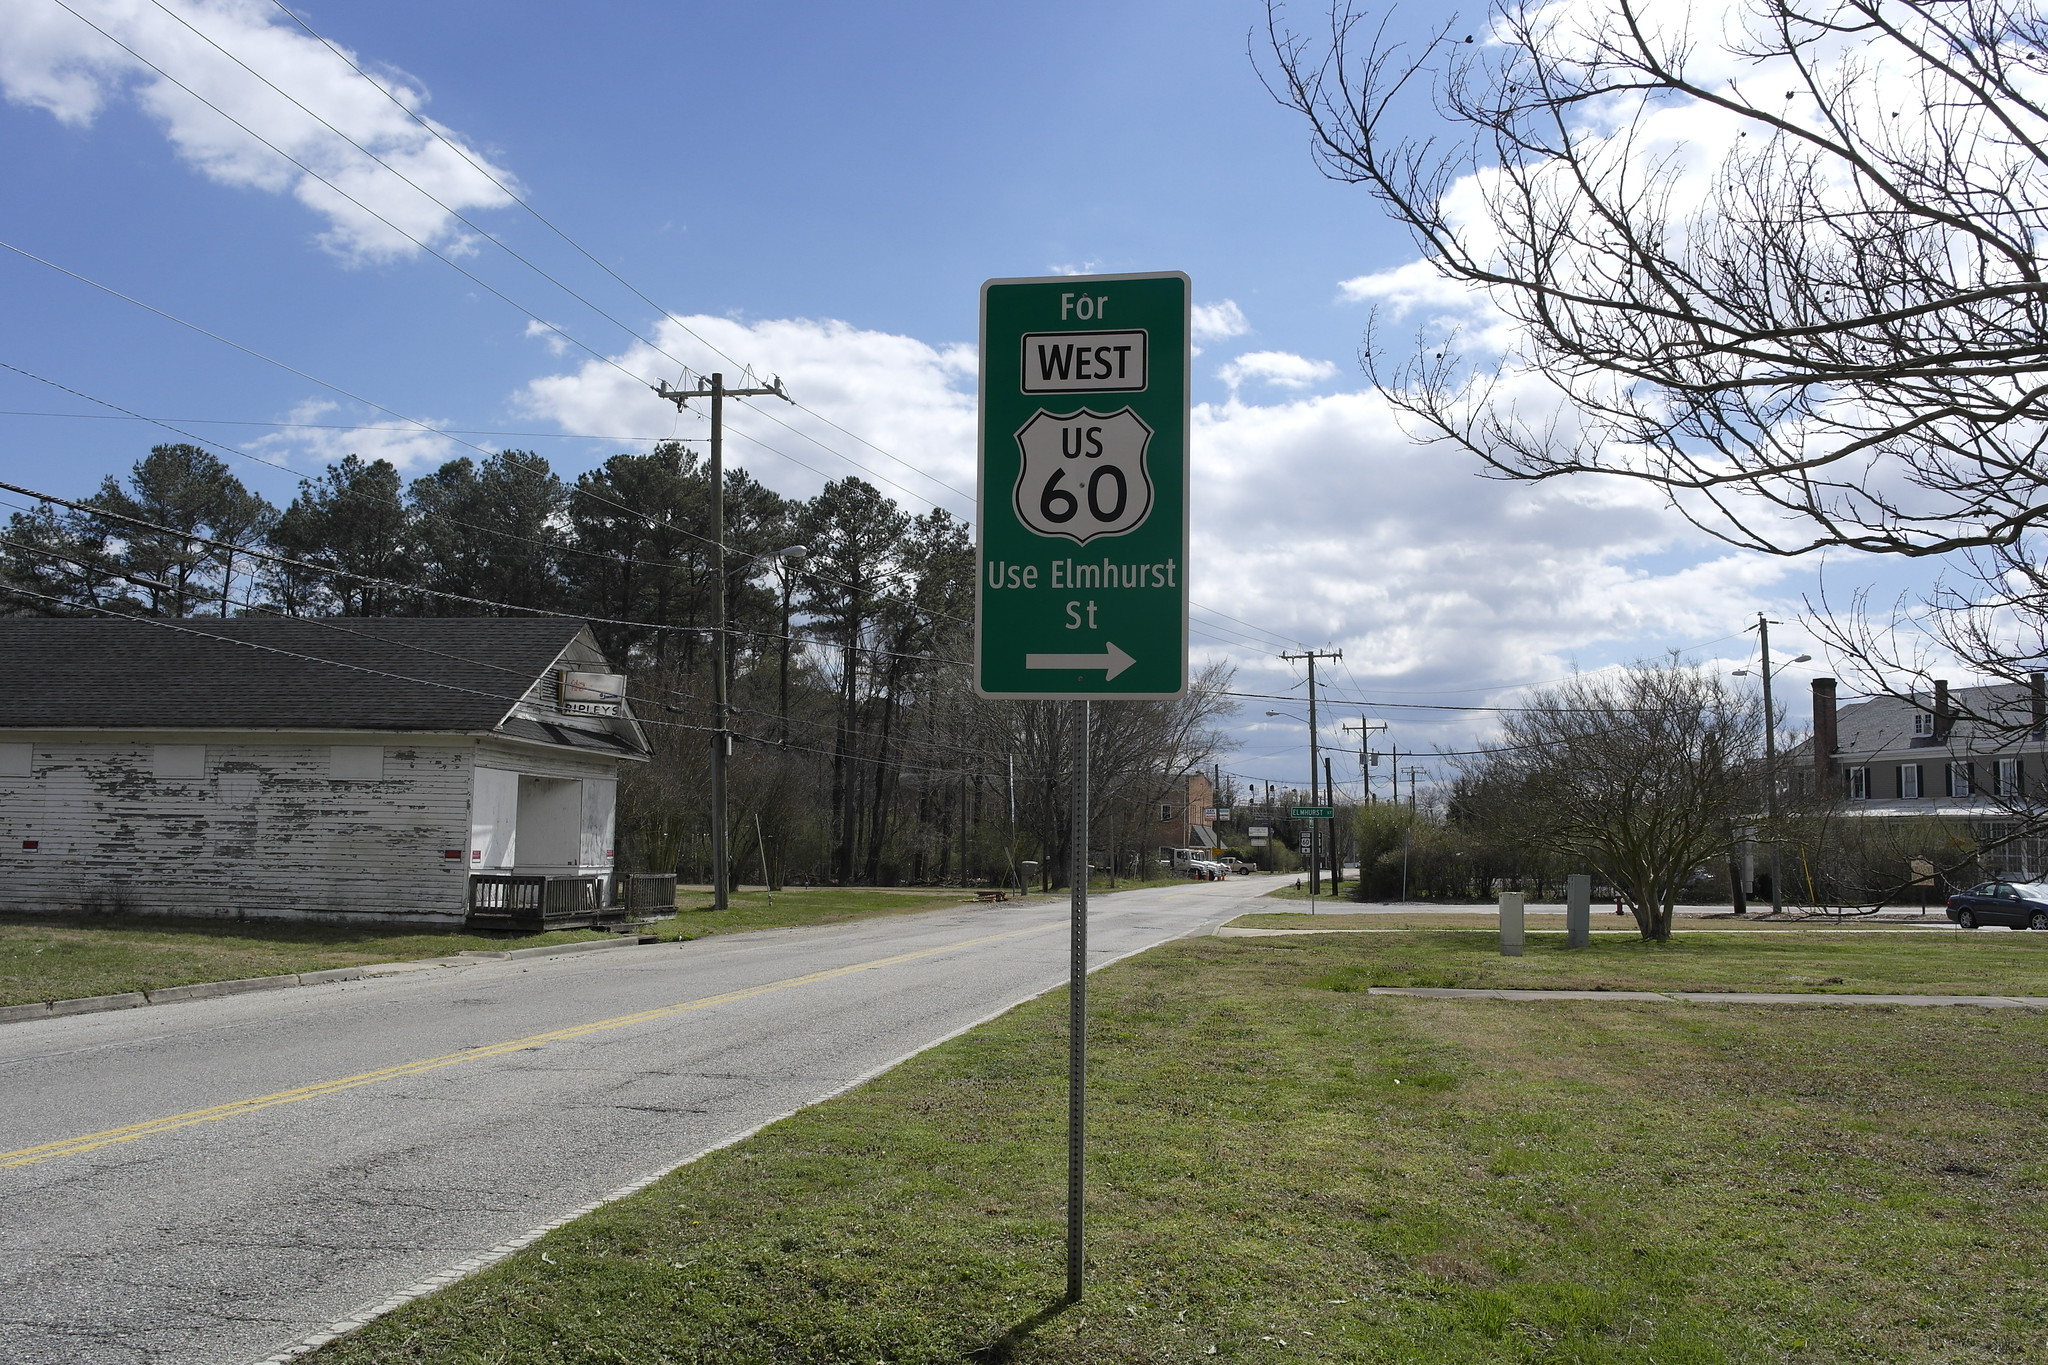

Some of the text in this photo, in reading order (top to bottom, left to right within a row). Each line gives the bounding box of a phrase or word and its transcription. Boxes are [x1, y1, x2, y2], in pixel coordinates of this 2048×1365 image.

[1061, 292, 1108, 320] For
[1037, 344, 1132, 380] WEST
[1062, 426, 1103, 458] US
[1040, 464, 1127, 523] 60
[988, 558, 1176, 589] Use Elmhurst
[1065, 600, 1098, 629] St
